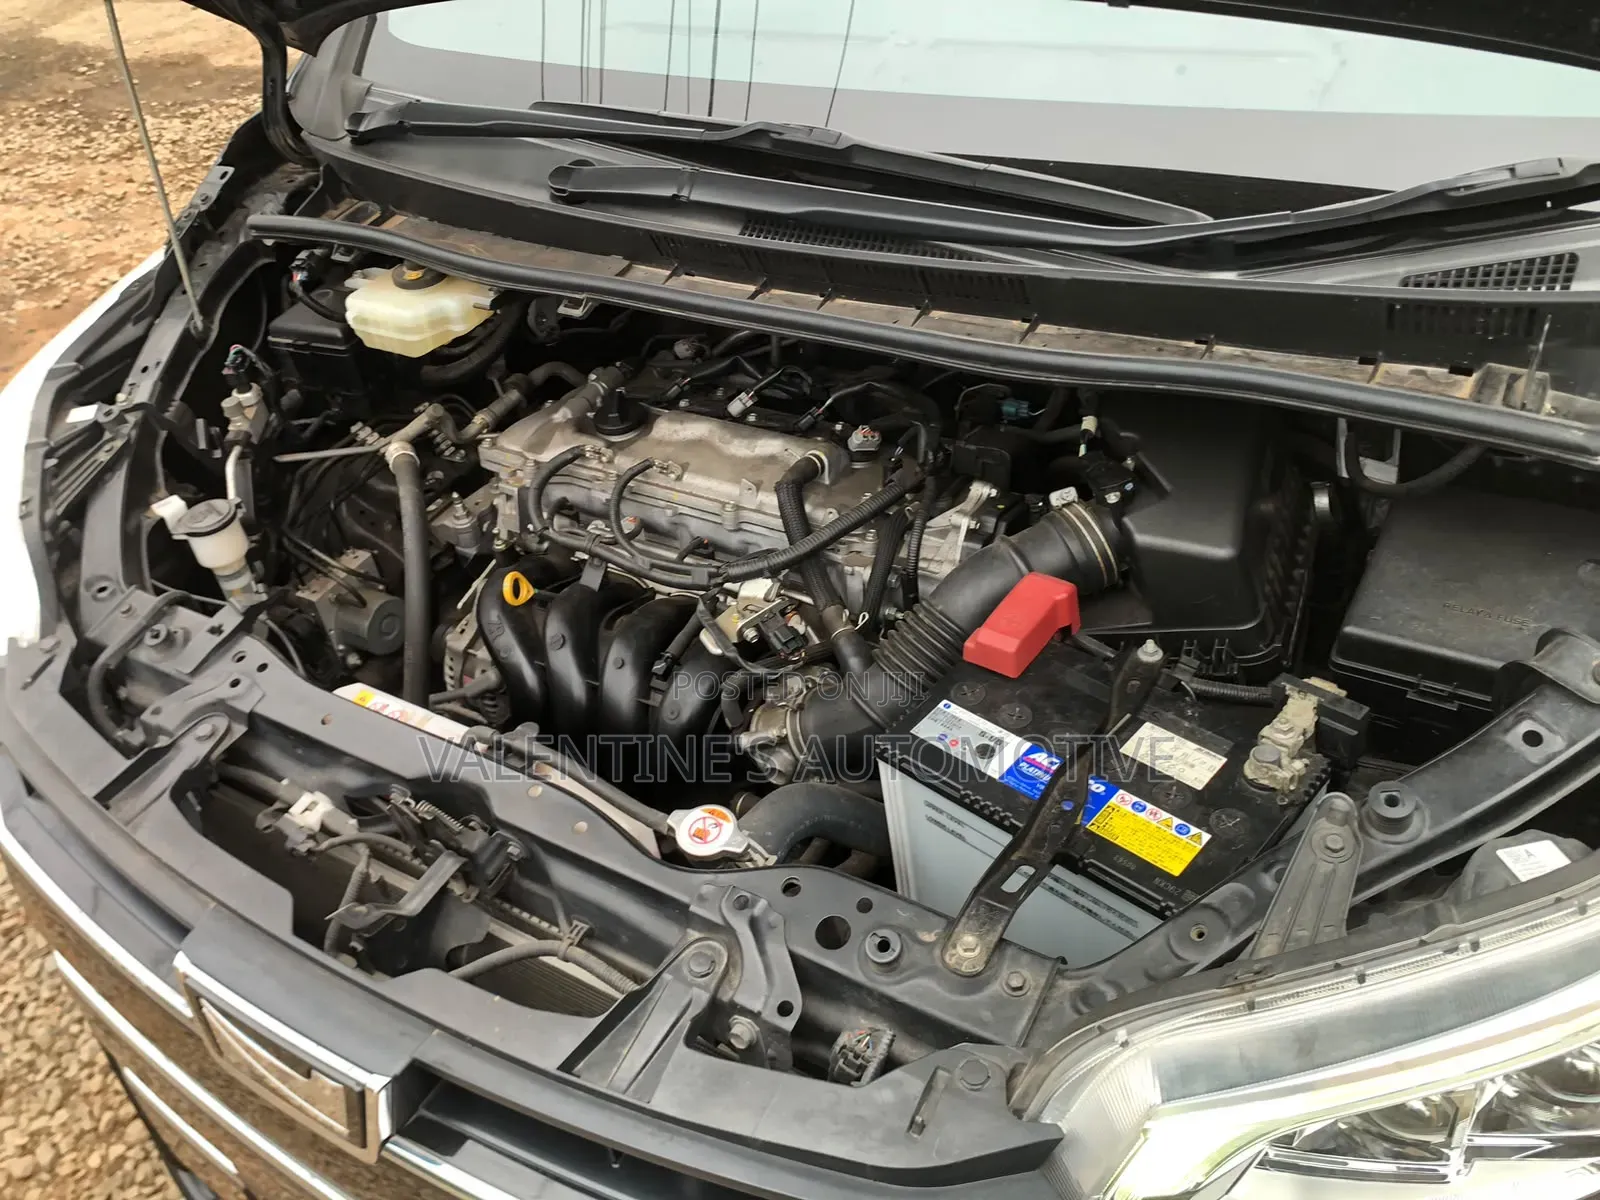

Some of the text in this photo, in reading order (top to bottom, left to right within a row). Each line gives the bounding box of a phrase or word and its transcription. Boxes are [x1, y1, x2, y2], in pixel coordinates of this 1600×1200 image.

[1442, 602, 1484, 617] RELAY
[1496, 614, 1530, 627] FUSE
[1018, 761, 1052, 783] PLATINU
